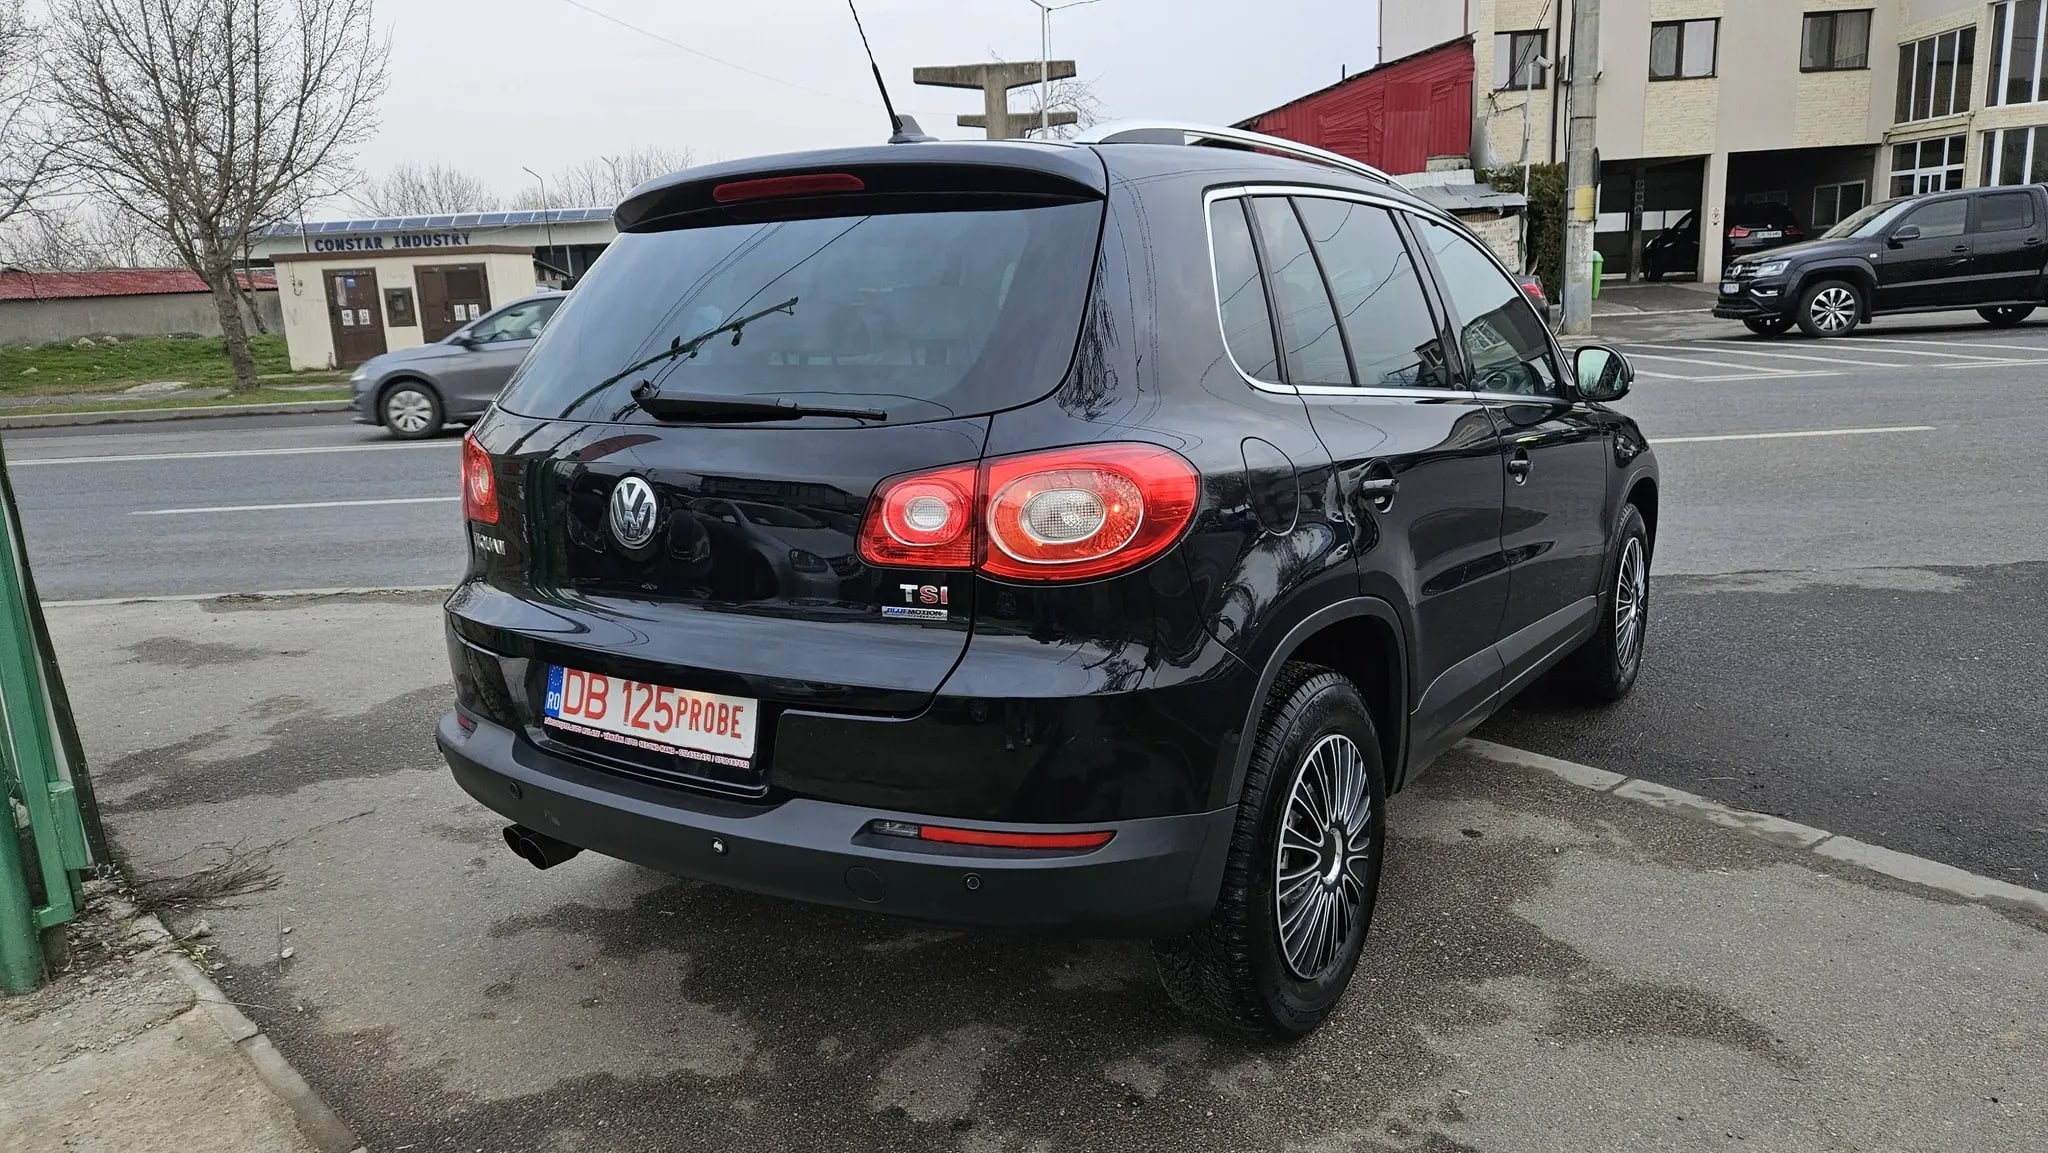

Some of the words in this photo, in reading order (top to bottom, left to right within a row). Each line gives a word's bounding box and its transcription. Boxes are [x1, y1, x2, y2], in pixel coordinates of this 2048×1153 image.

[315, 236, 383, 252] CONSTAR
[393, 232, 471, 249] INDUSTRY
[899, 583, 948, 604] TSI
[547, 691, 560, 711] RO
[563, 668, 609, 720] DB
[622, 679, 675, 733] 125
[675, 696, 744, 739] PROBE
